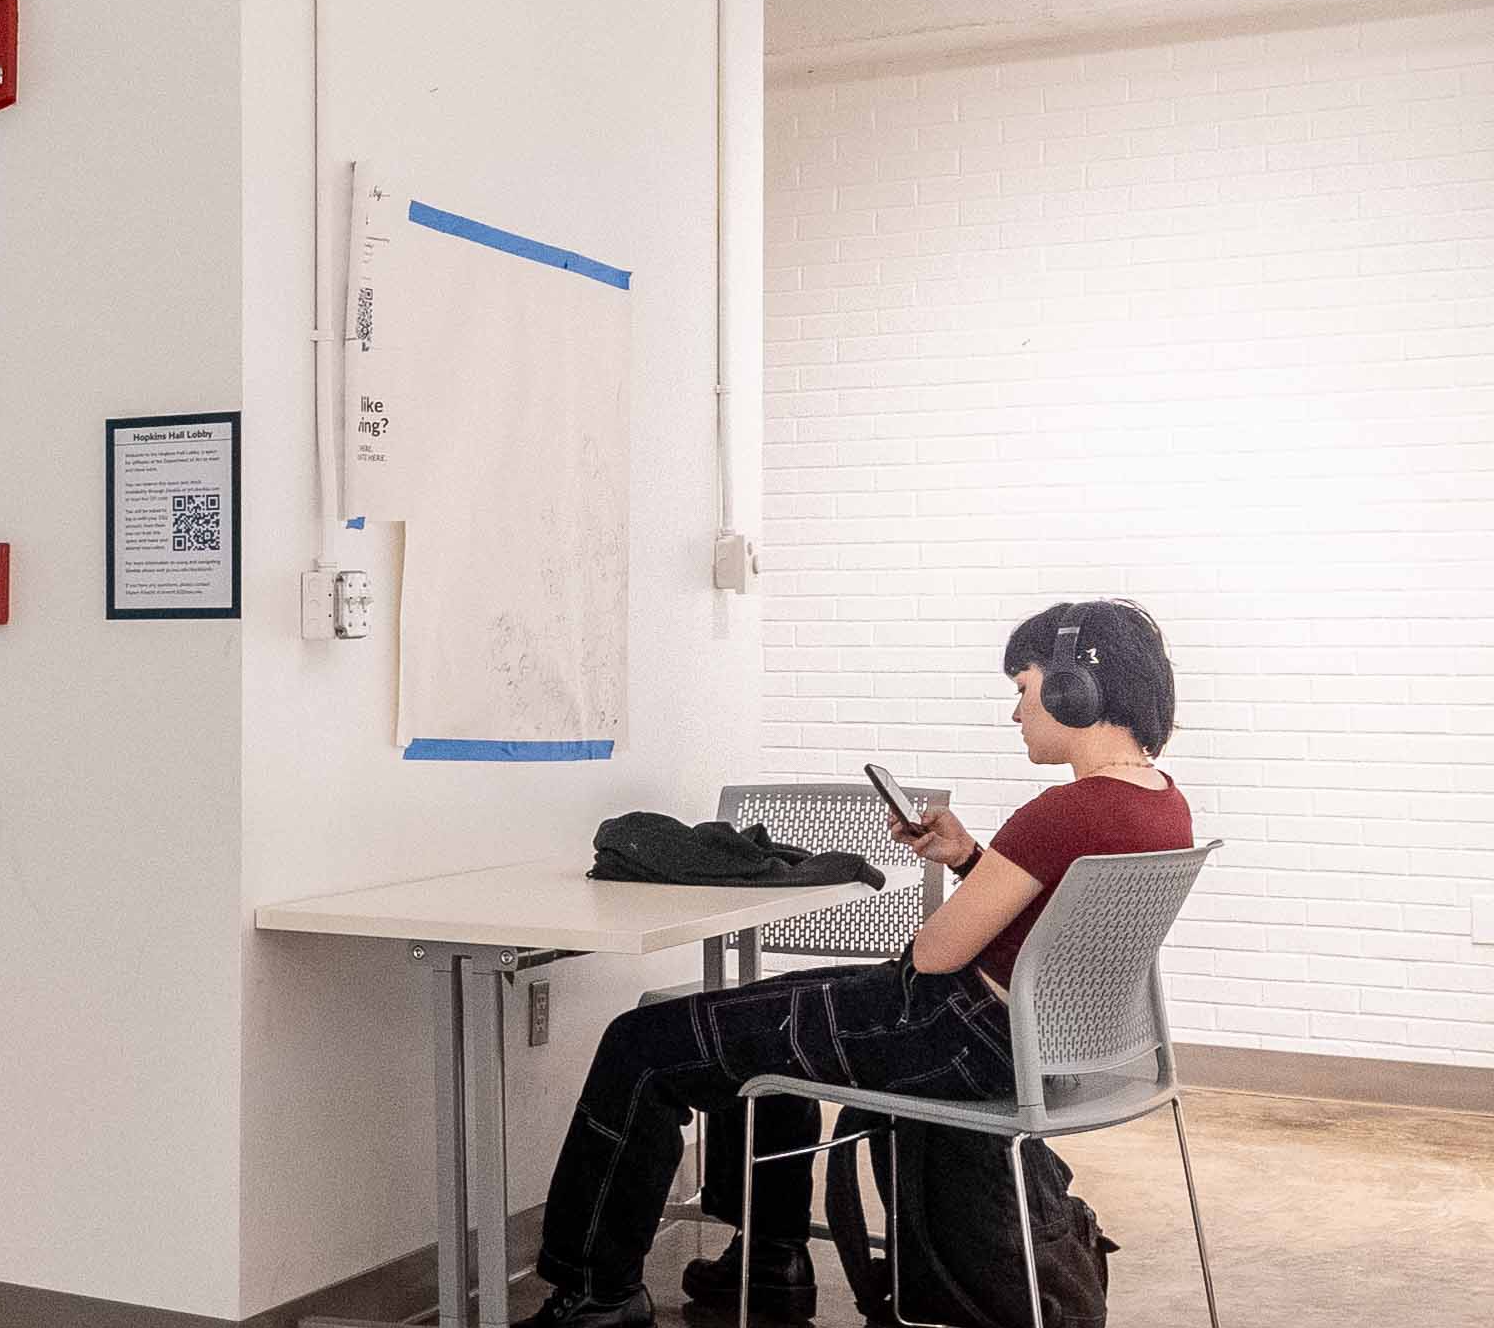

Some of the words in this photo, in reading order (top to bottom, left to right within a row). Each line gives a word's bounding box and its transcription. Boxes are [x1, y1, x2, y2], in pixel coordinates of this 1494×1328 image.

[361, 396, 384, 413] like
[133, 432, 167, 442] Hopkins
[168, 430, 185, 440] Hall
[186, 429, 214, 439] Lobby
